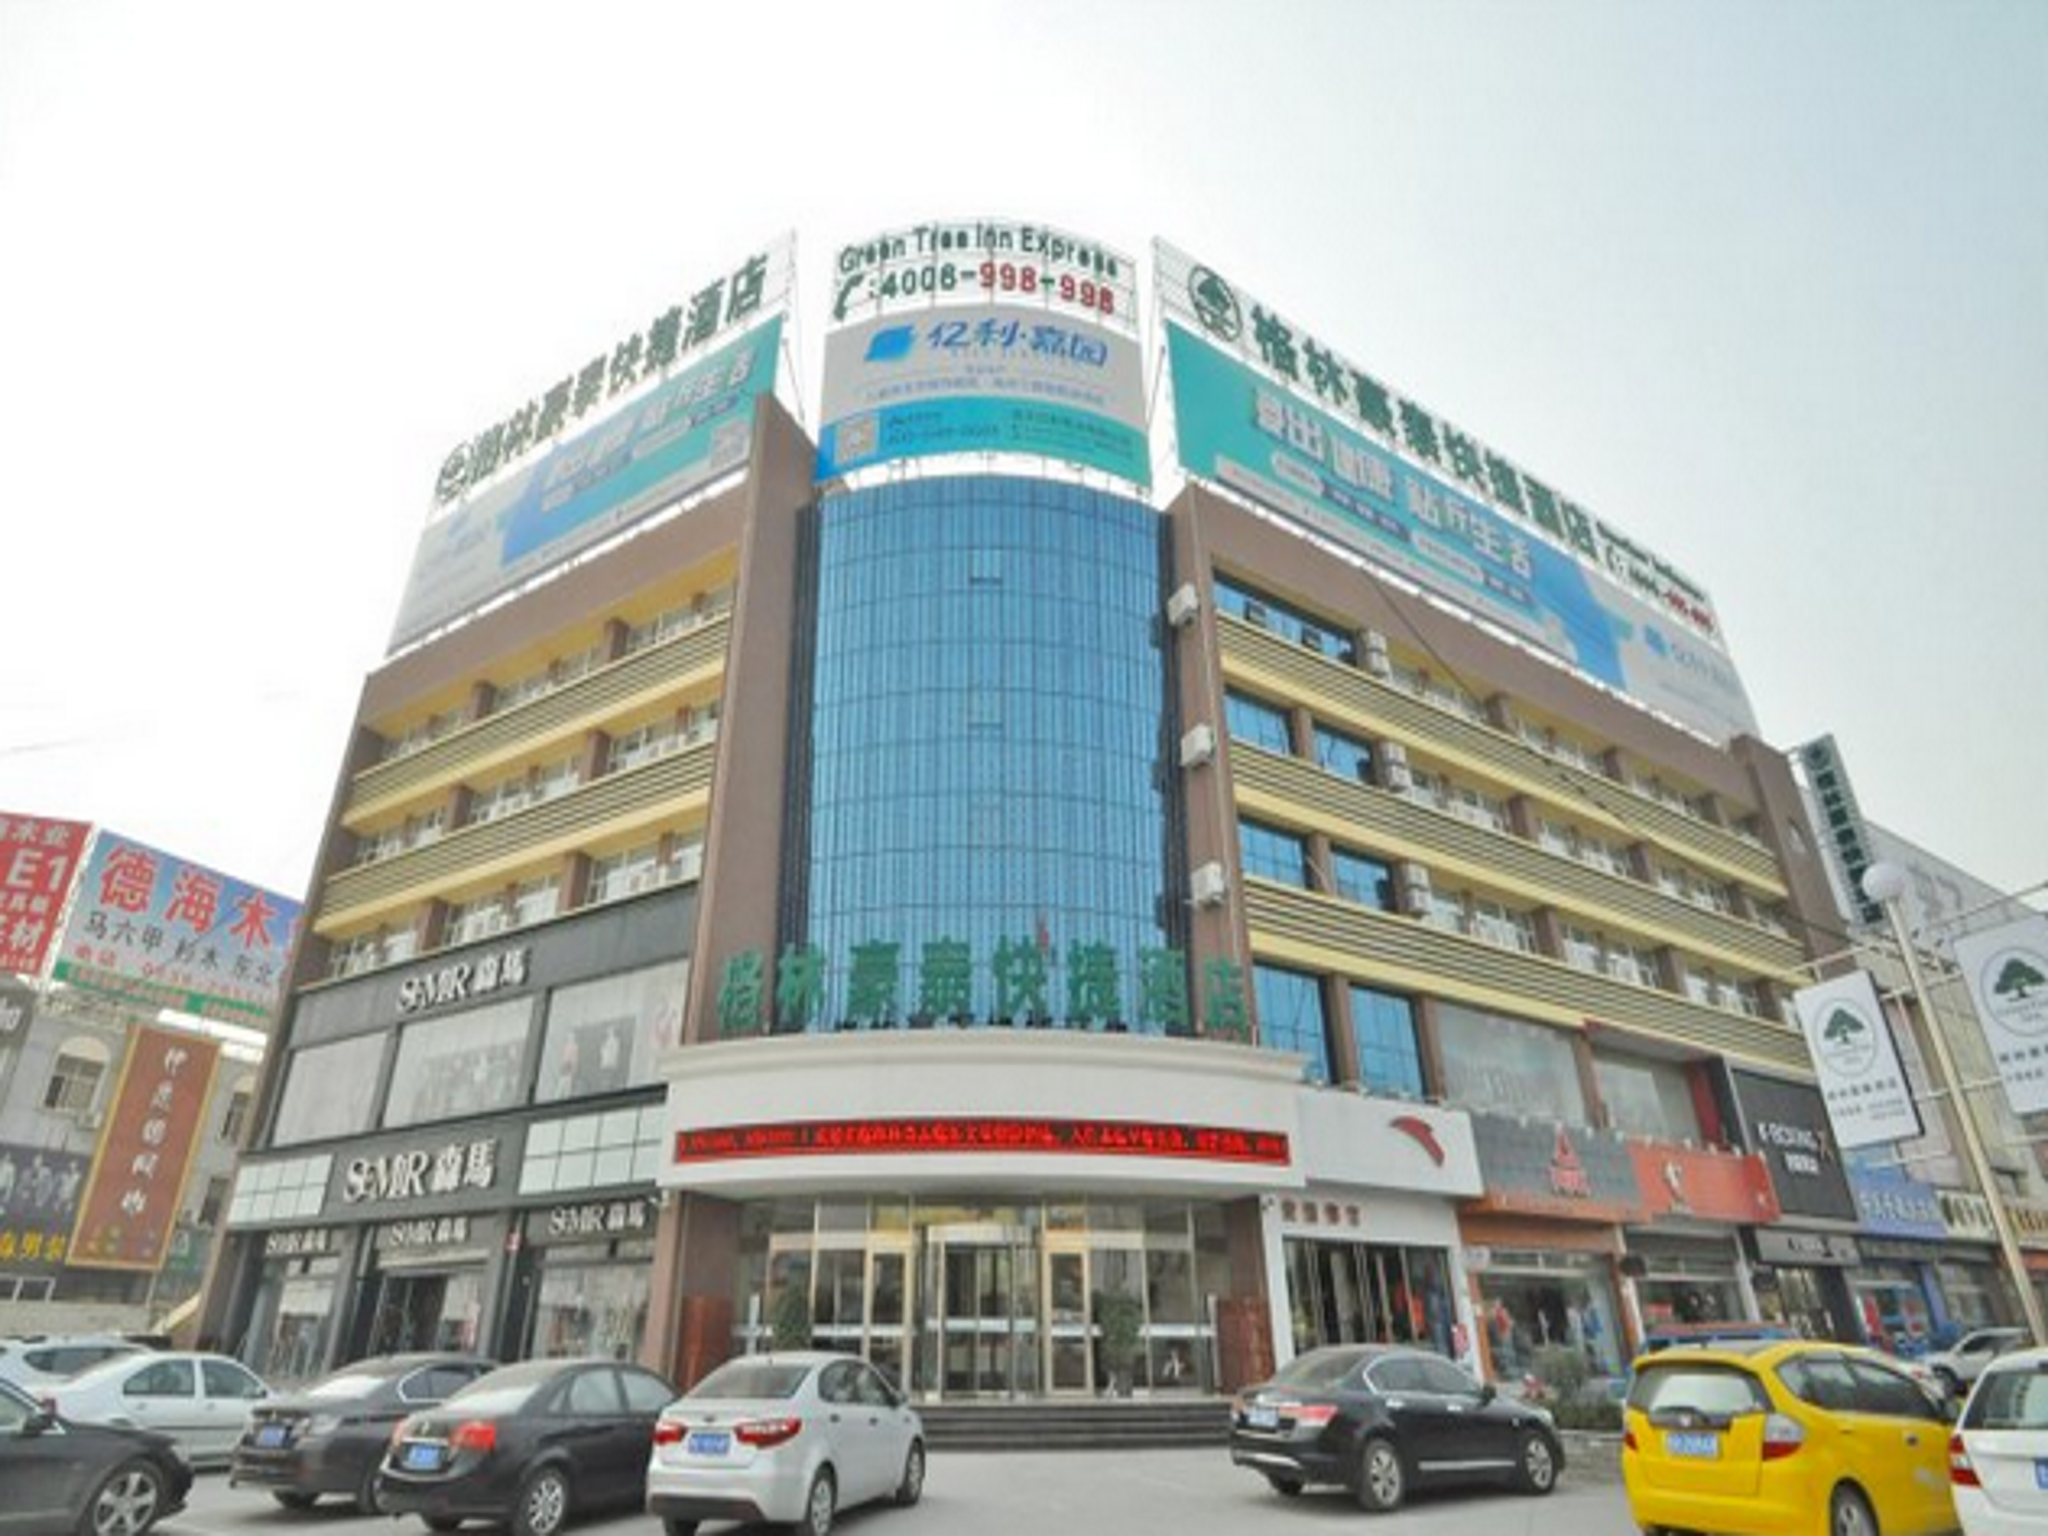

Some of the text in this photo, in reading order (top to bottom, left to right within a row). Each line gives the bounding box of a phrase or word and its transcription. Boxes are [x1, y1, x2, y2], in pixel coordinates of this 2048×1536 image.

[839, 222, 1118, 277] Green Tree Inn Express
[100, 844, 303, 960] 德海木
[718, 935, 1249, 1040] 格林豪泰快捷酒店
